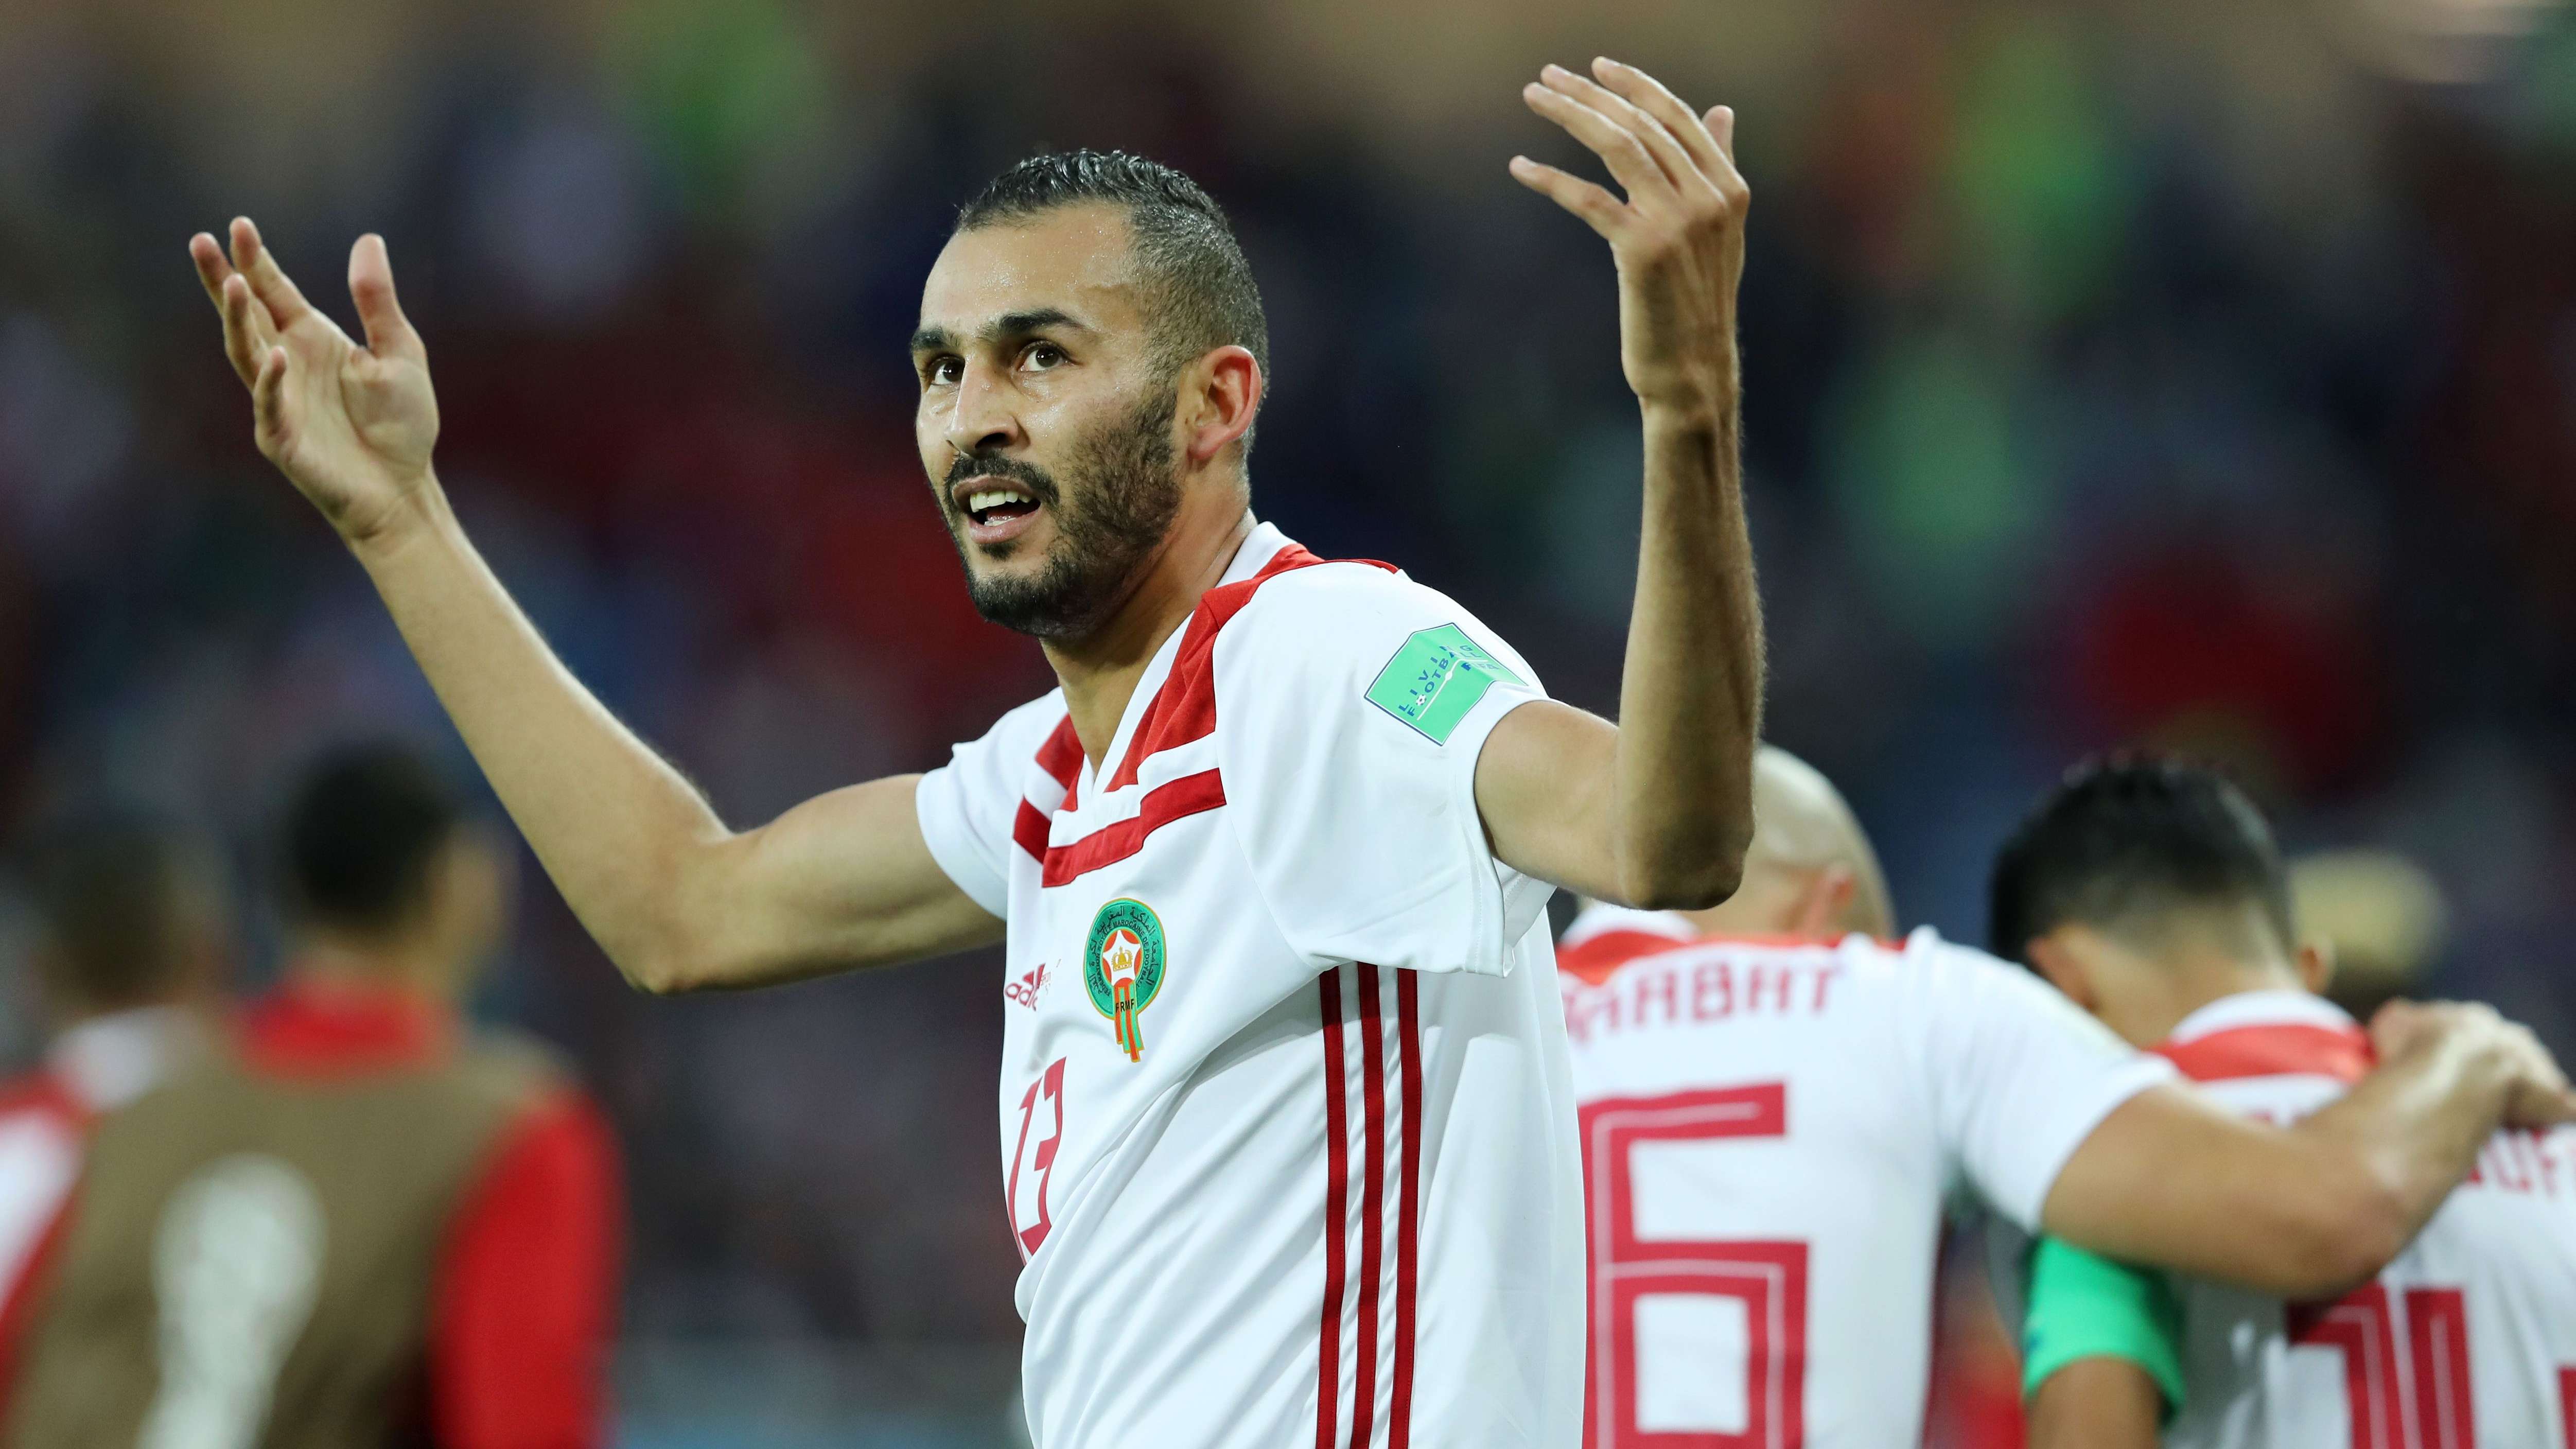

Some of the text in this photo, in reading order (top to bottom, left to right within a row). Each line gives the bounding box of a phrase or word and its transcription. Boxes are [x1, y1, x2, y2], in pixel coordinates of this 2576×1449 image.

[1115, 998, 1134, 1013] FRMF
[1561, 962, 1843, 1050] RABAT
[1008, 1056, 1066, 1267] 13
[1578, 1080, 1809, 1449] 6
